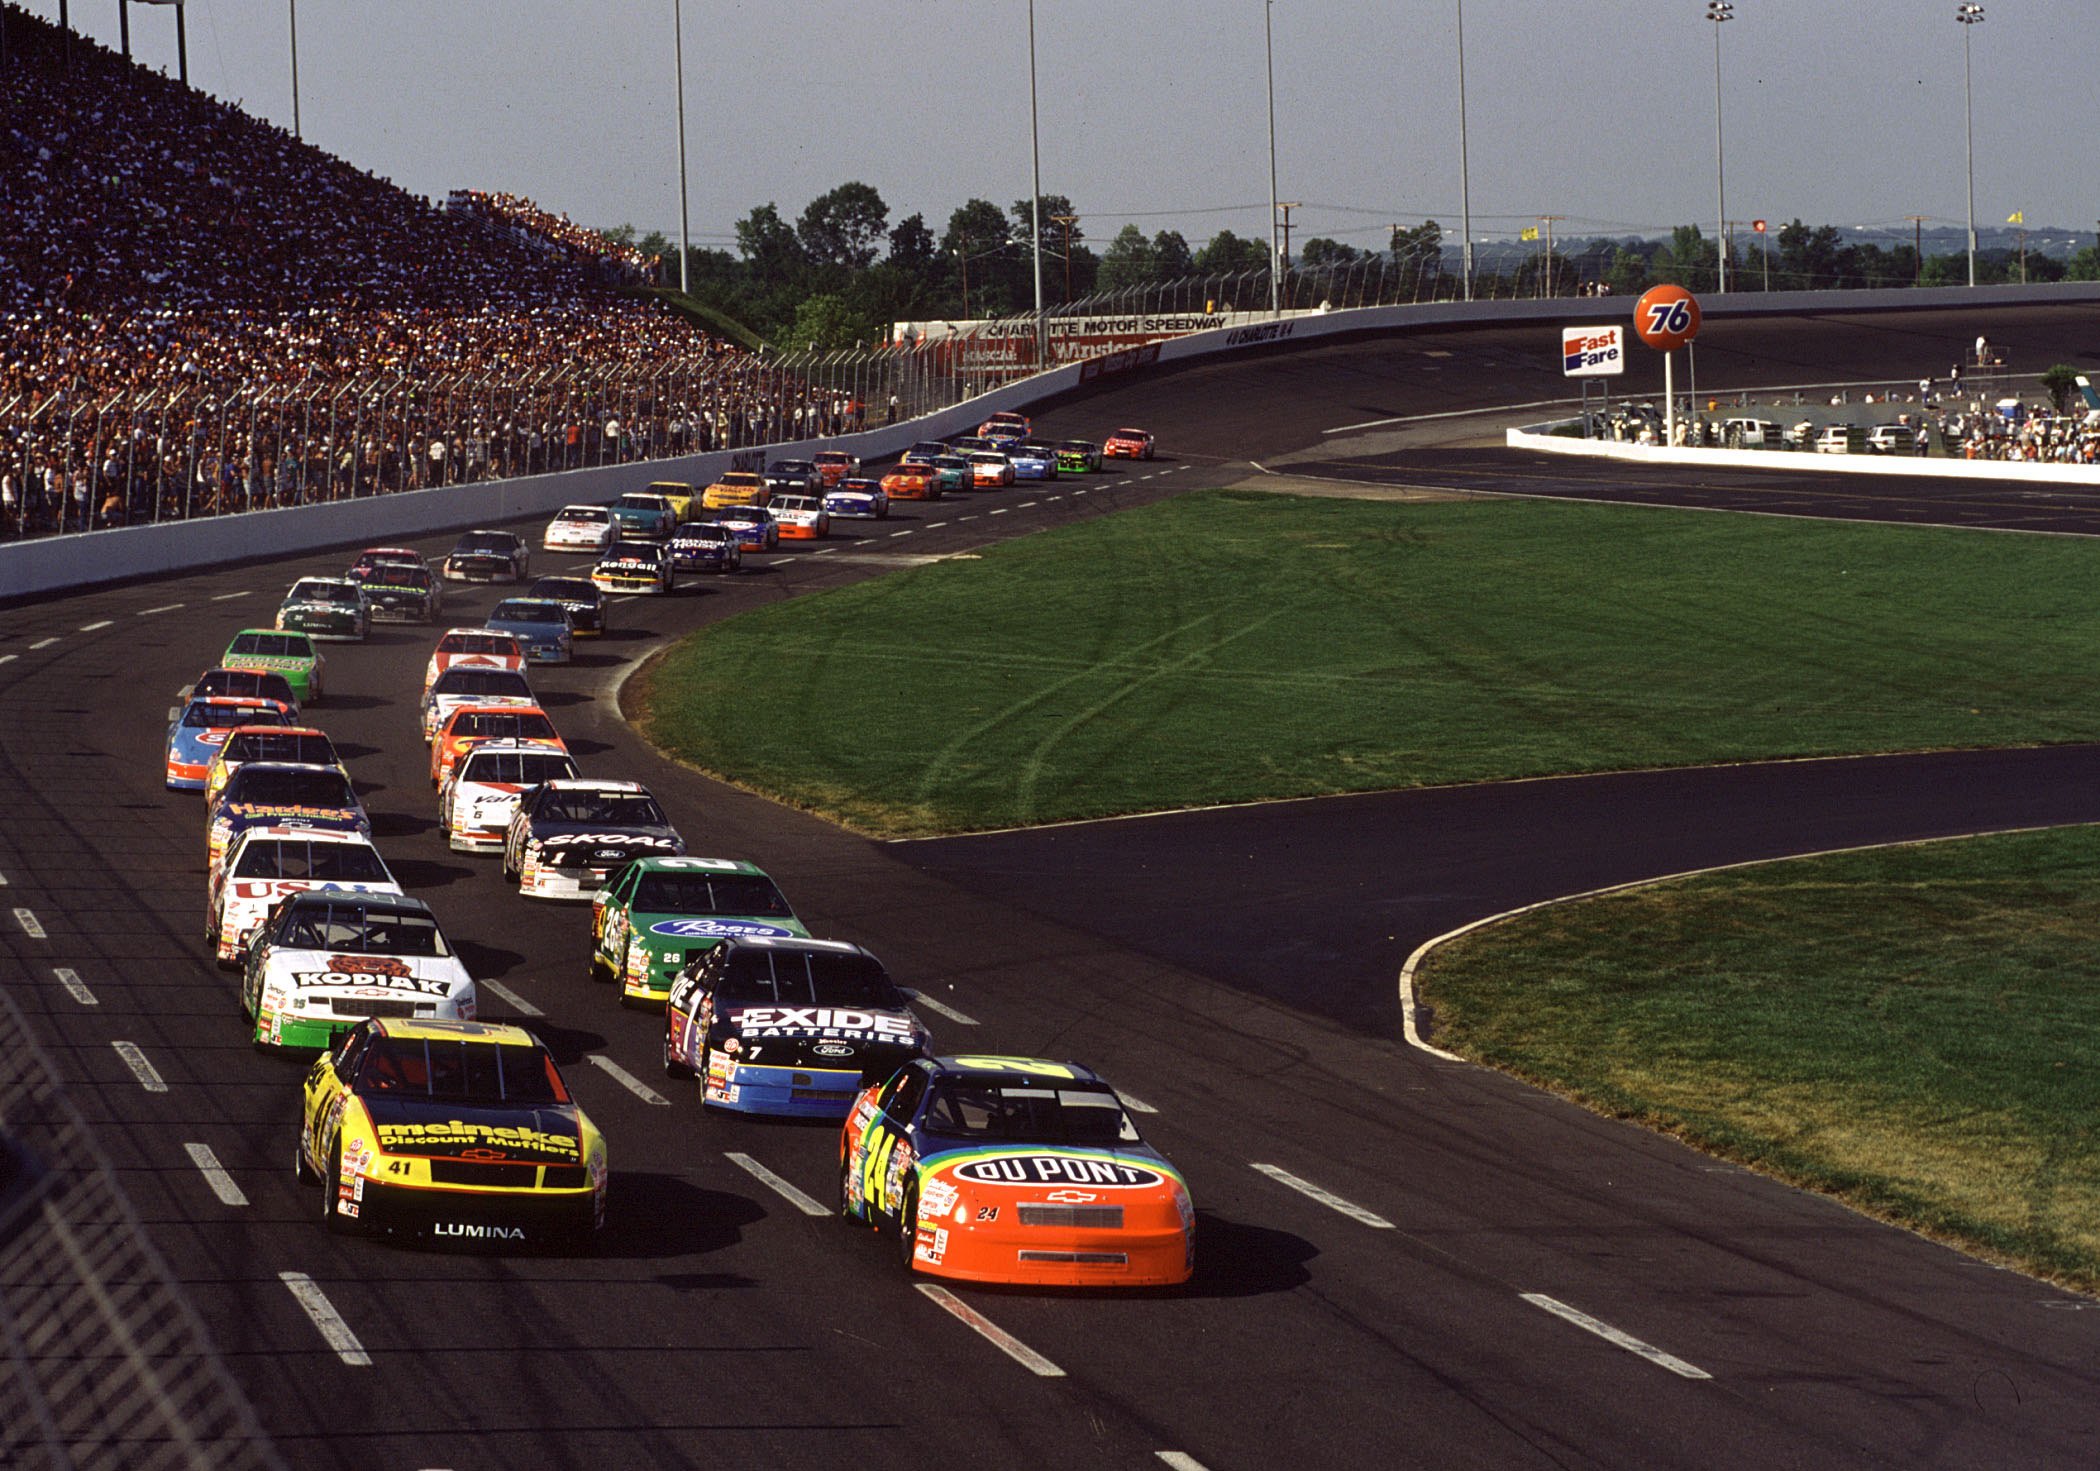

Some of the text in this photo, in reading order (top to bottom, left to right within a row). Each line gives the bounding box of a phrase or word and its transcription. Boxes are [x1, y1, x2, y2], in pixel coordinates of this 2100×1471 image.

[647, 299, 691, 334] 76
[988, 317, 1226, 337] CHARTTE MOTOR SPEEDWAY
[1052, 340, 1140, 359] Winsto
[1565, 330, 1616, 355] Fast
[1565, 348, 1618, 371] Fare
[601, 561, 657, 572] Kendall
[229, 803, 356, 819] Hardee's
[474, 811, 483, 819] 6
[544, 834, 673, 848] SKOAL
[551, 852, 565, 864] 1
[663, 953, 681, 963] 26
[298, 972, 445, 995] KODIAK
[738, 1008, 910, 1036] EXIDE
[741, 1027, 915, 1045] BATTERIES
[749, 1046, 762, 1060] 7
[377, 1120, 576, 1147] meineke
[381, 1135, 580, 1158] Discount Mufflers
[388, 1162, 411, 1175] 41
[863, 1125, 896, 1212] 24
[1032, 1158, 1139, 1183] PONT
[976, 1206, 1001, 1222] 24
[434, 1222, 526, 1240] LUMINA
